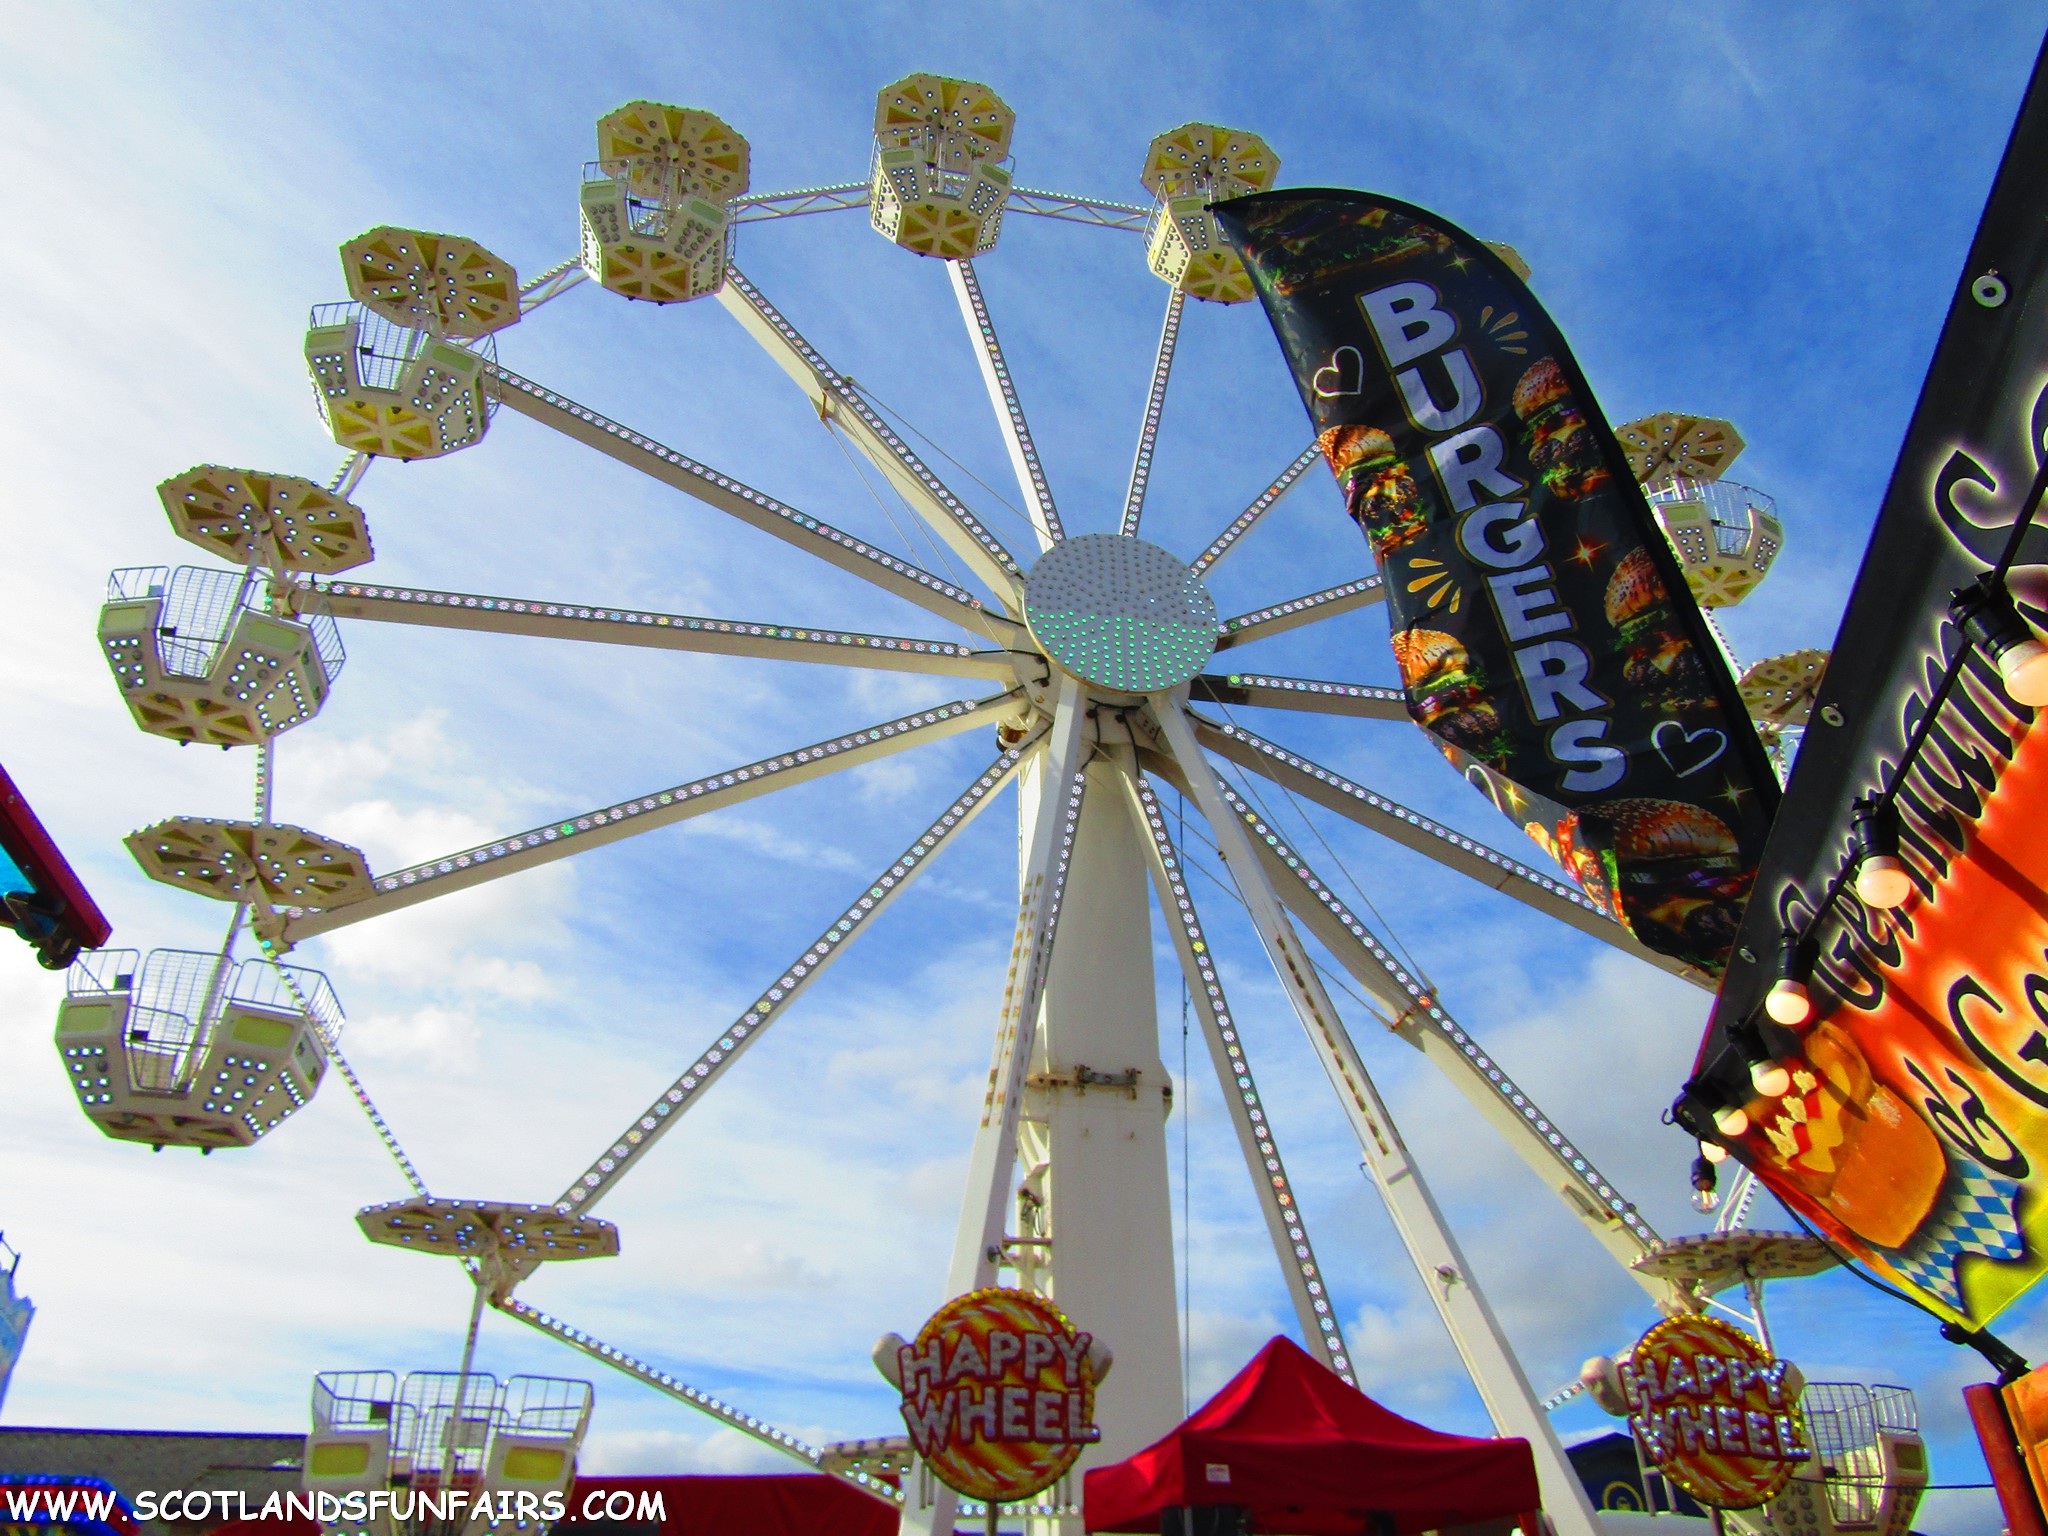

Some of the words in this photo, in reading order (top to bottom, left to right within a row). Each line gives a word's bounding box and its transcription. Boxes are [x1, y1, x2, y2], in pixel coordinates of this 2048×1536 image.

[1356, 280, 1631, 796] BURGERS
[1903, 1056, 2030, 1179] &
[899, 1330, 1092, 1397] HAPPY
[1617, 1352, 1787, 1411] HAPPY
[900, 1384, 1100, 1457] WHEEL
[1629, 1403, 1811, 1465] WHEEL
